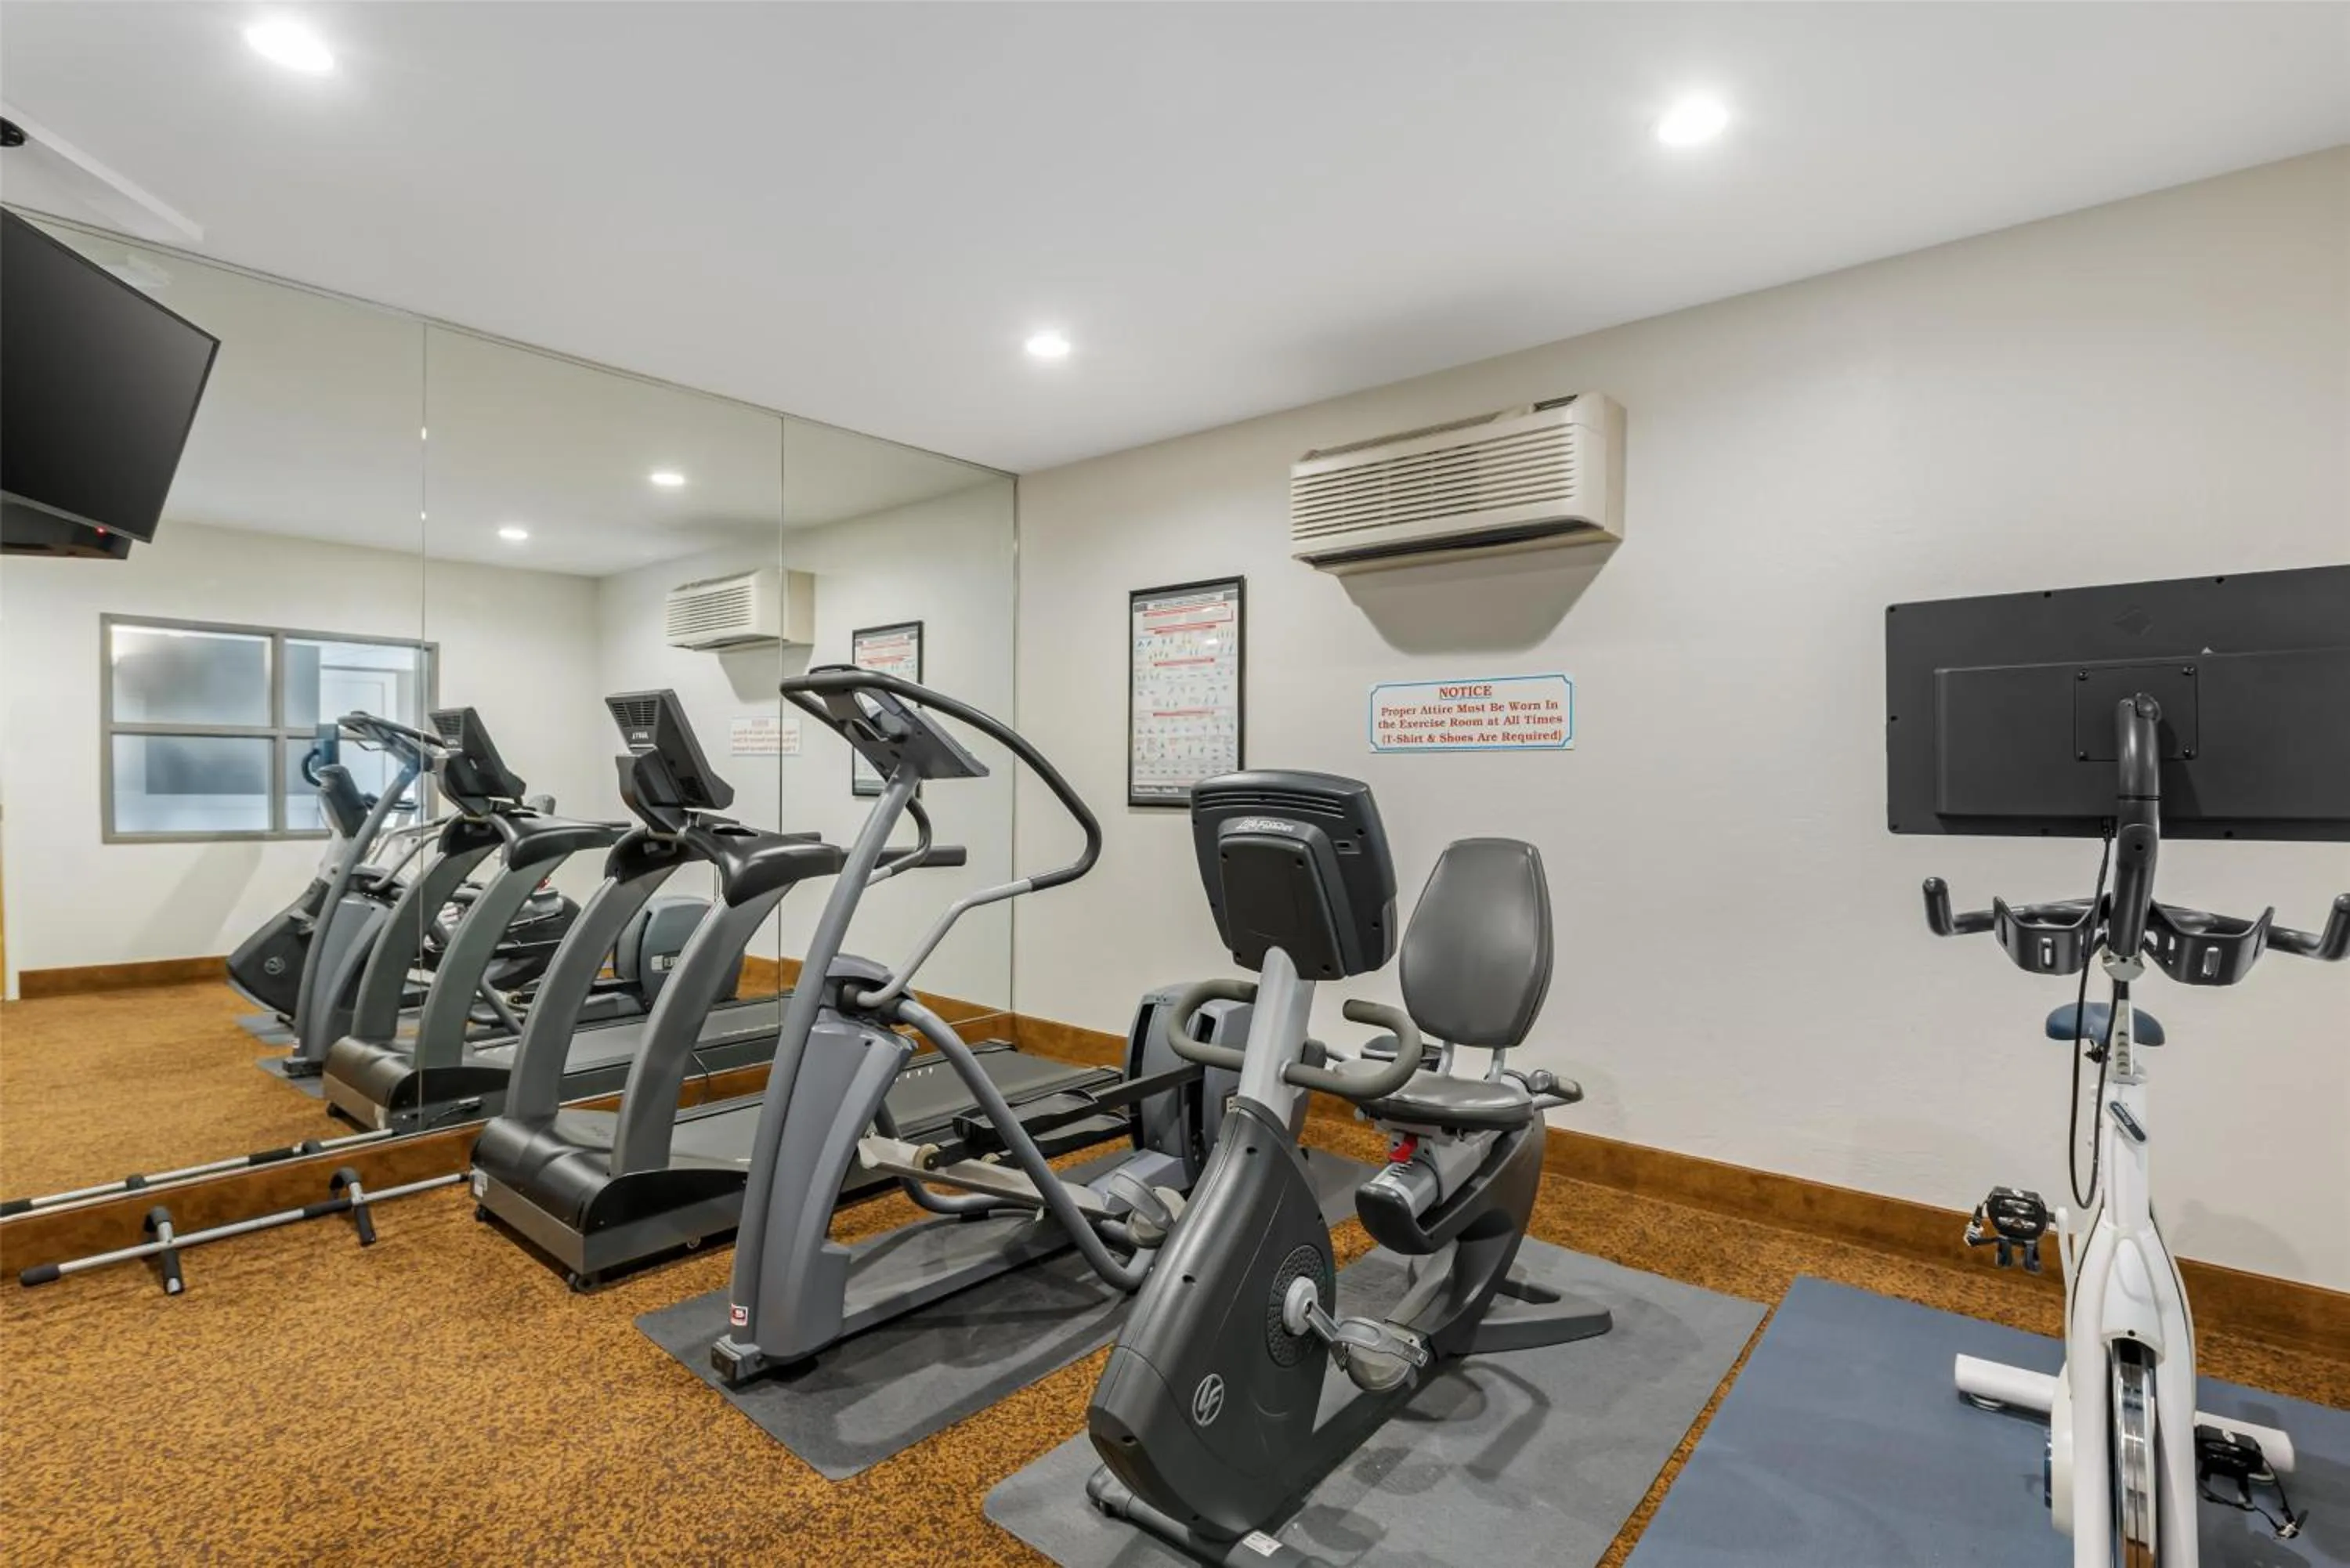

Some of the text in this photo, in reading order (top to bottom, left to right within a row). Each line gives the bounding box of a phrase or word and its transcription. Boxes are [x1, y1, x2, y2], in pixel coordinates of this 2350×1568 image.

[1439, 685, 1492, 697] NOTICE
[1381, 699, 1559, 717] Proper Attire Must Be Worn In
[1378, 714, 1564, 729] the Exercise Room at All Times
[1382, 729, 1561, 745] (T-Shirt & Shoes Are Required)
